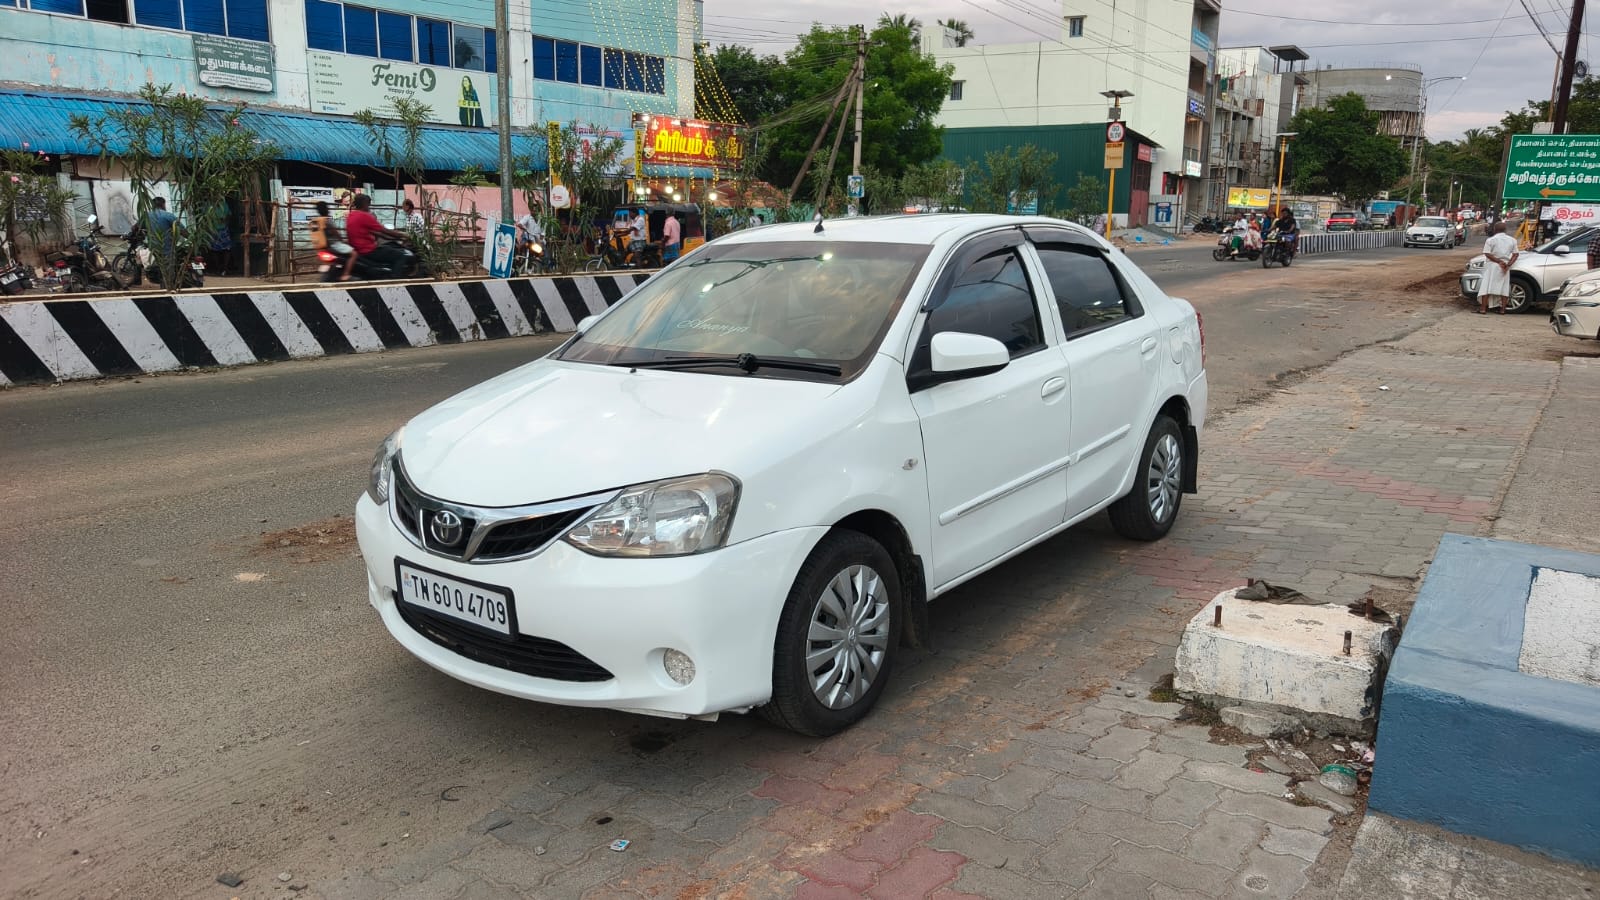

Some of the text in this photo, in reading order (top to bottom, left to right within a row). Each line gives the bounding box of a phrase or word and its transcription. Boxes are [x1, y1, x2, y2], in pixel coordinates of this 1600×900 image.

[198, 57, 270, 75] மதுபானக்கடை
[655, 129, 702, 155] பிரியம்
[1509, 170, 1600, 186] அறிவுத்திருக்கோ
[1555, 207, 1594, 219] இதம்
[411, 574, 506, 625] TN 60 Q 4709
